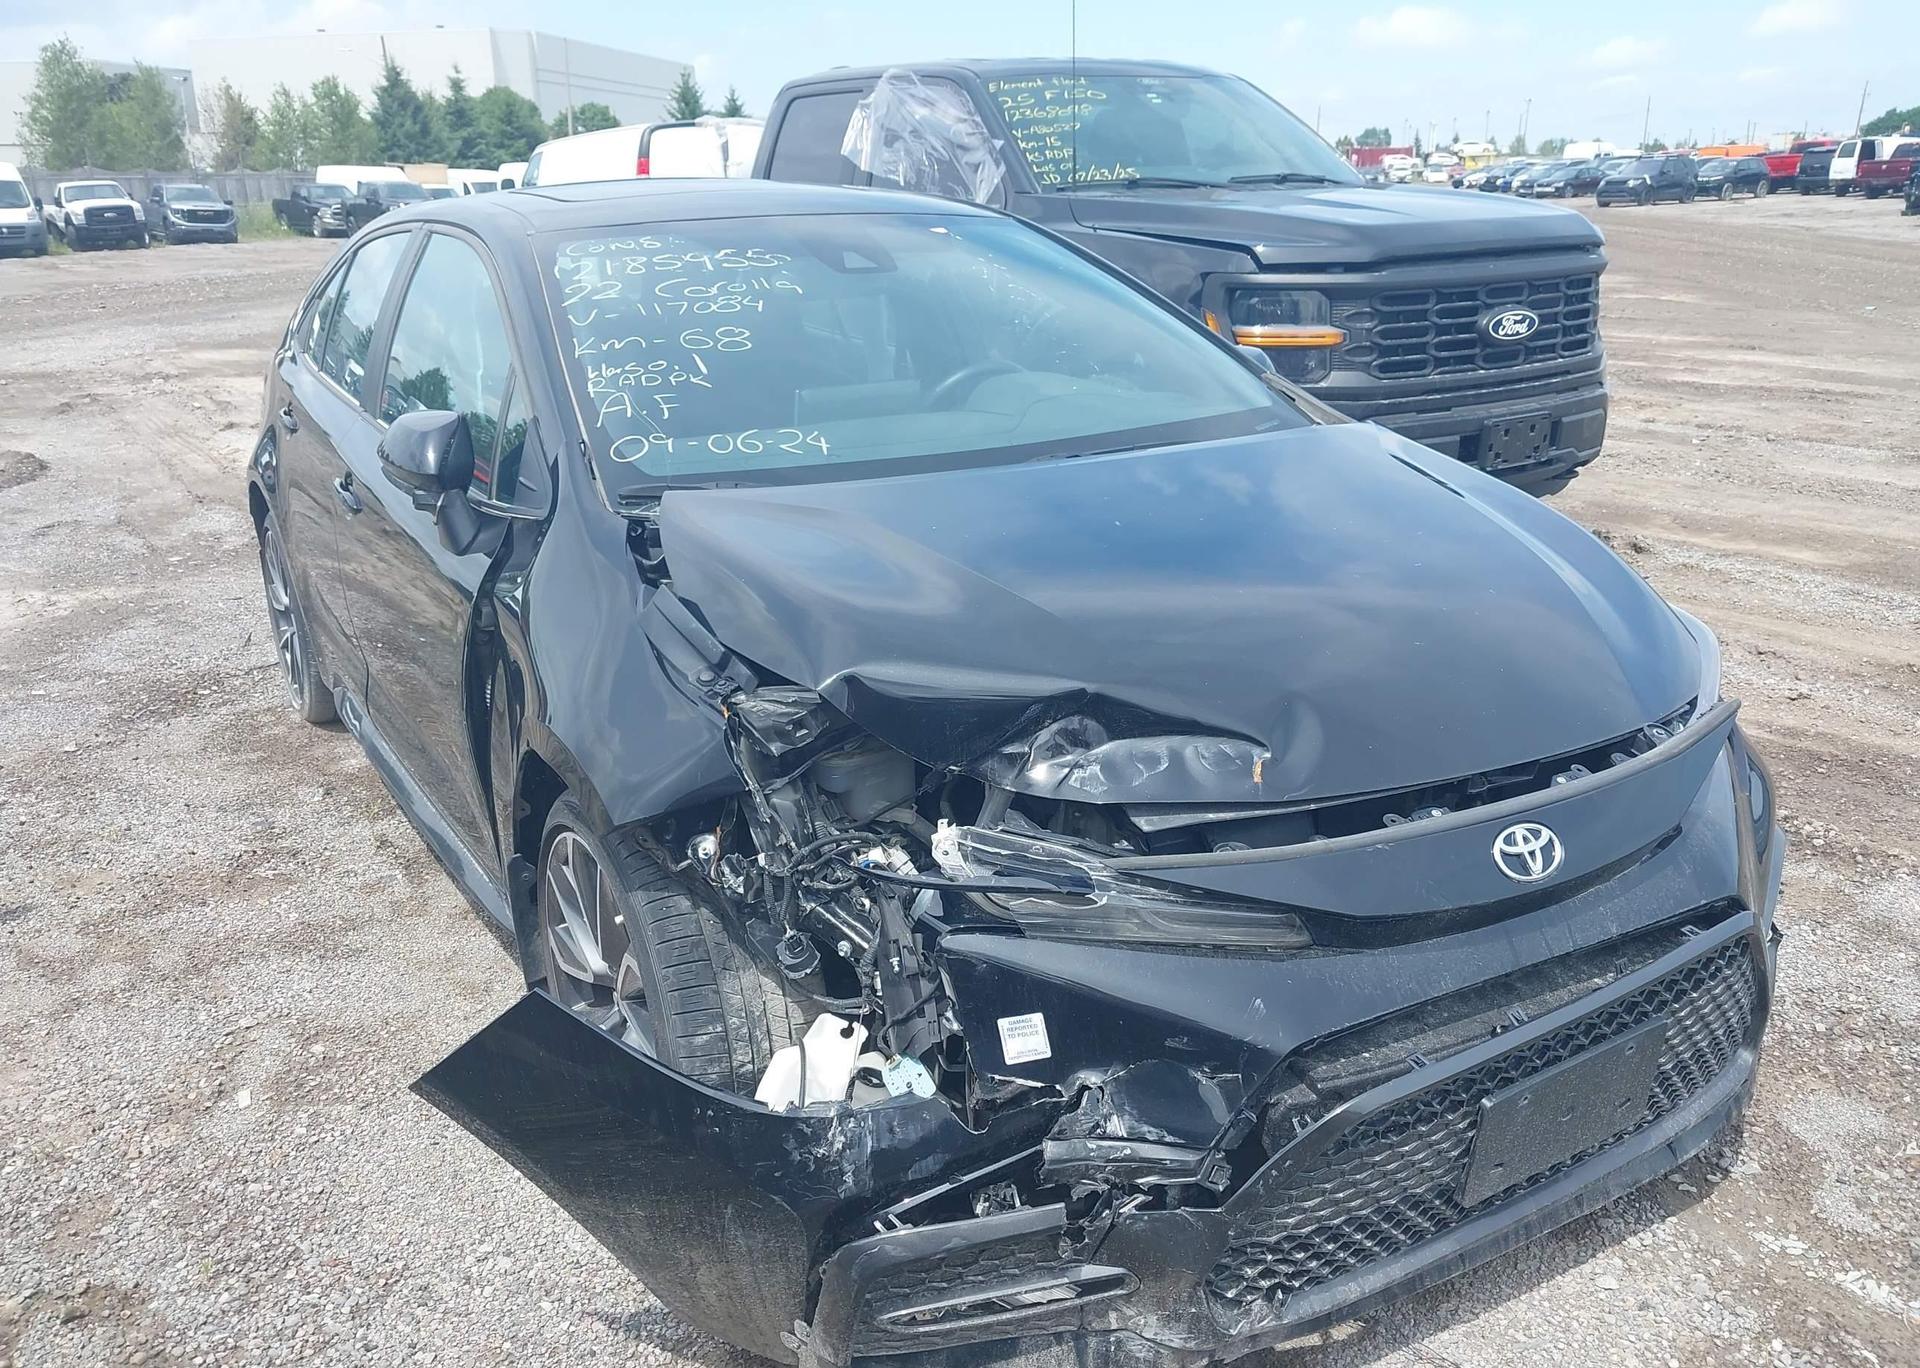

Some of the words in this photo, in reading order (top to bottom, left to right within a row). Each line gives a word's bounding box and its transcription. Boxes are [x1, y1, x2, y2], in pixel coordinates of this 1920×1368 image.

[1044, 87, 1108, 102] F150
[561, 282, 622, 307] 22
[655, 276, 803, 297] Corolla
[1498, 314, 1530, 336] Ford
[1008, 1017, 1033, 1026] DAMAGE
[1006, 1023, 1039, 1033] REPORTED
[1018, 1030, 1040, 1039] POLICE
